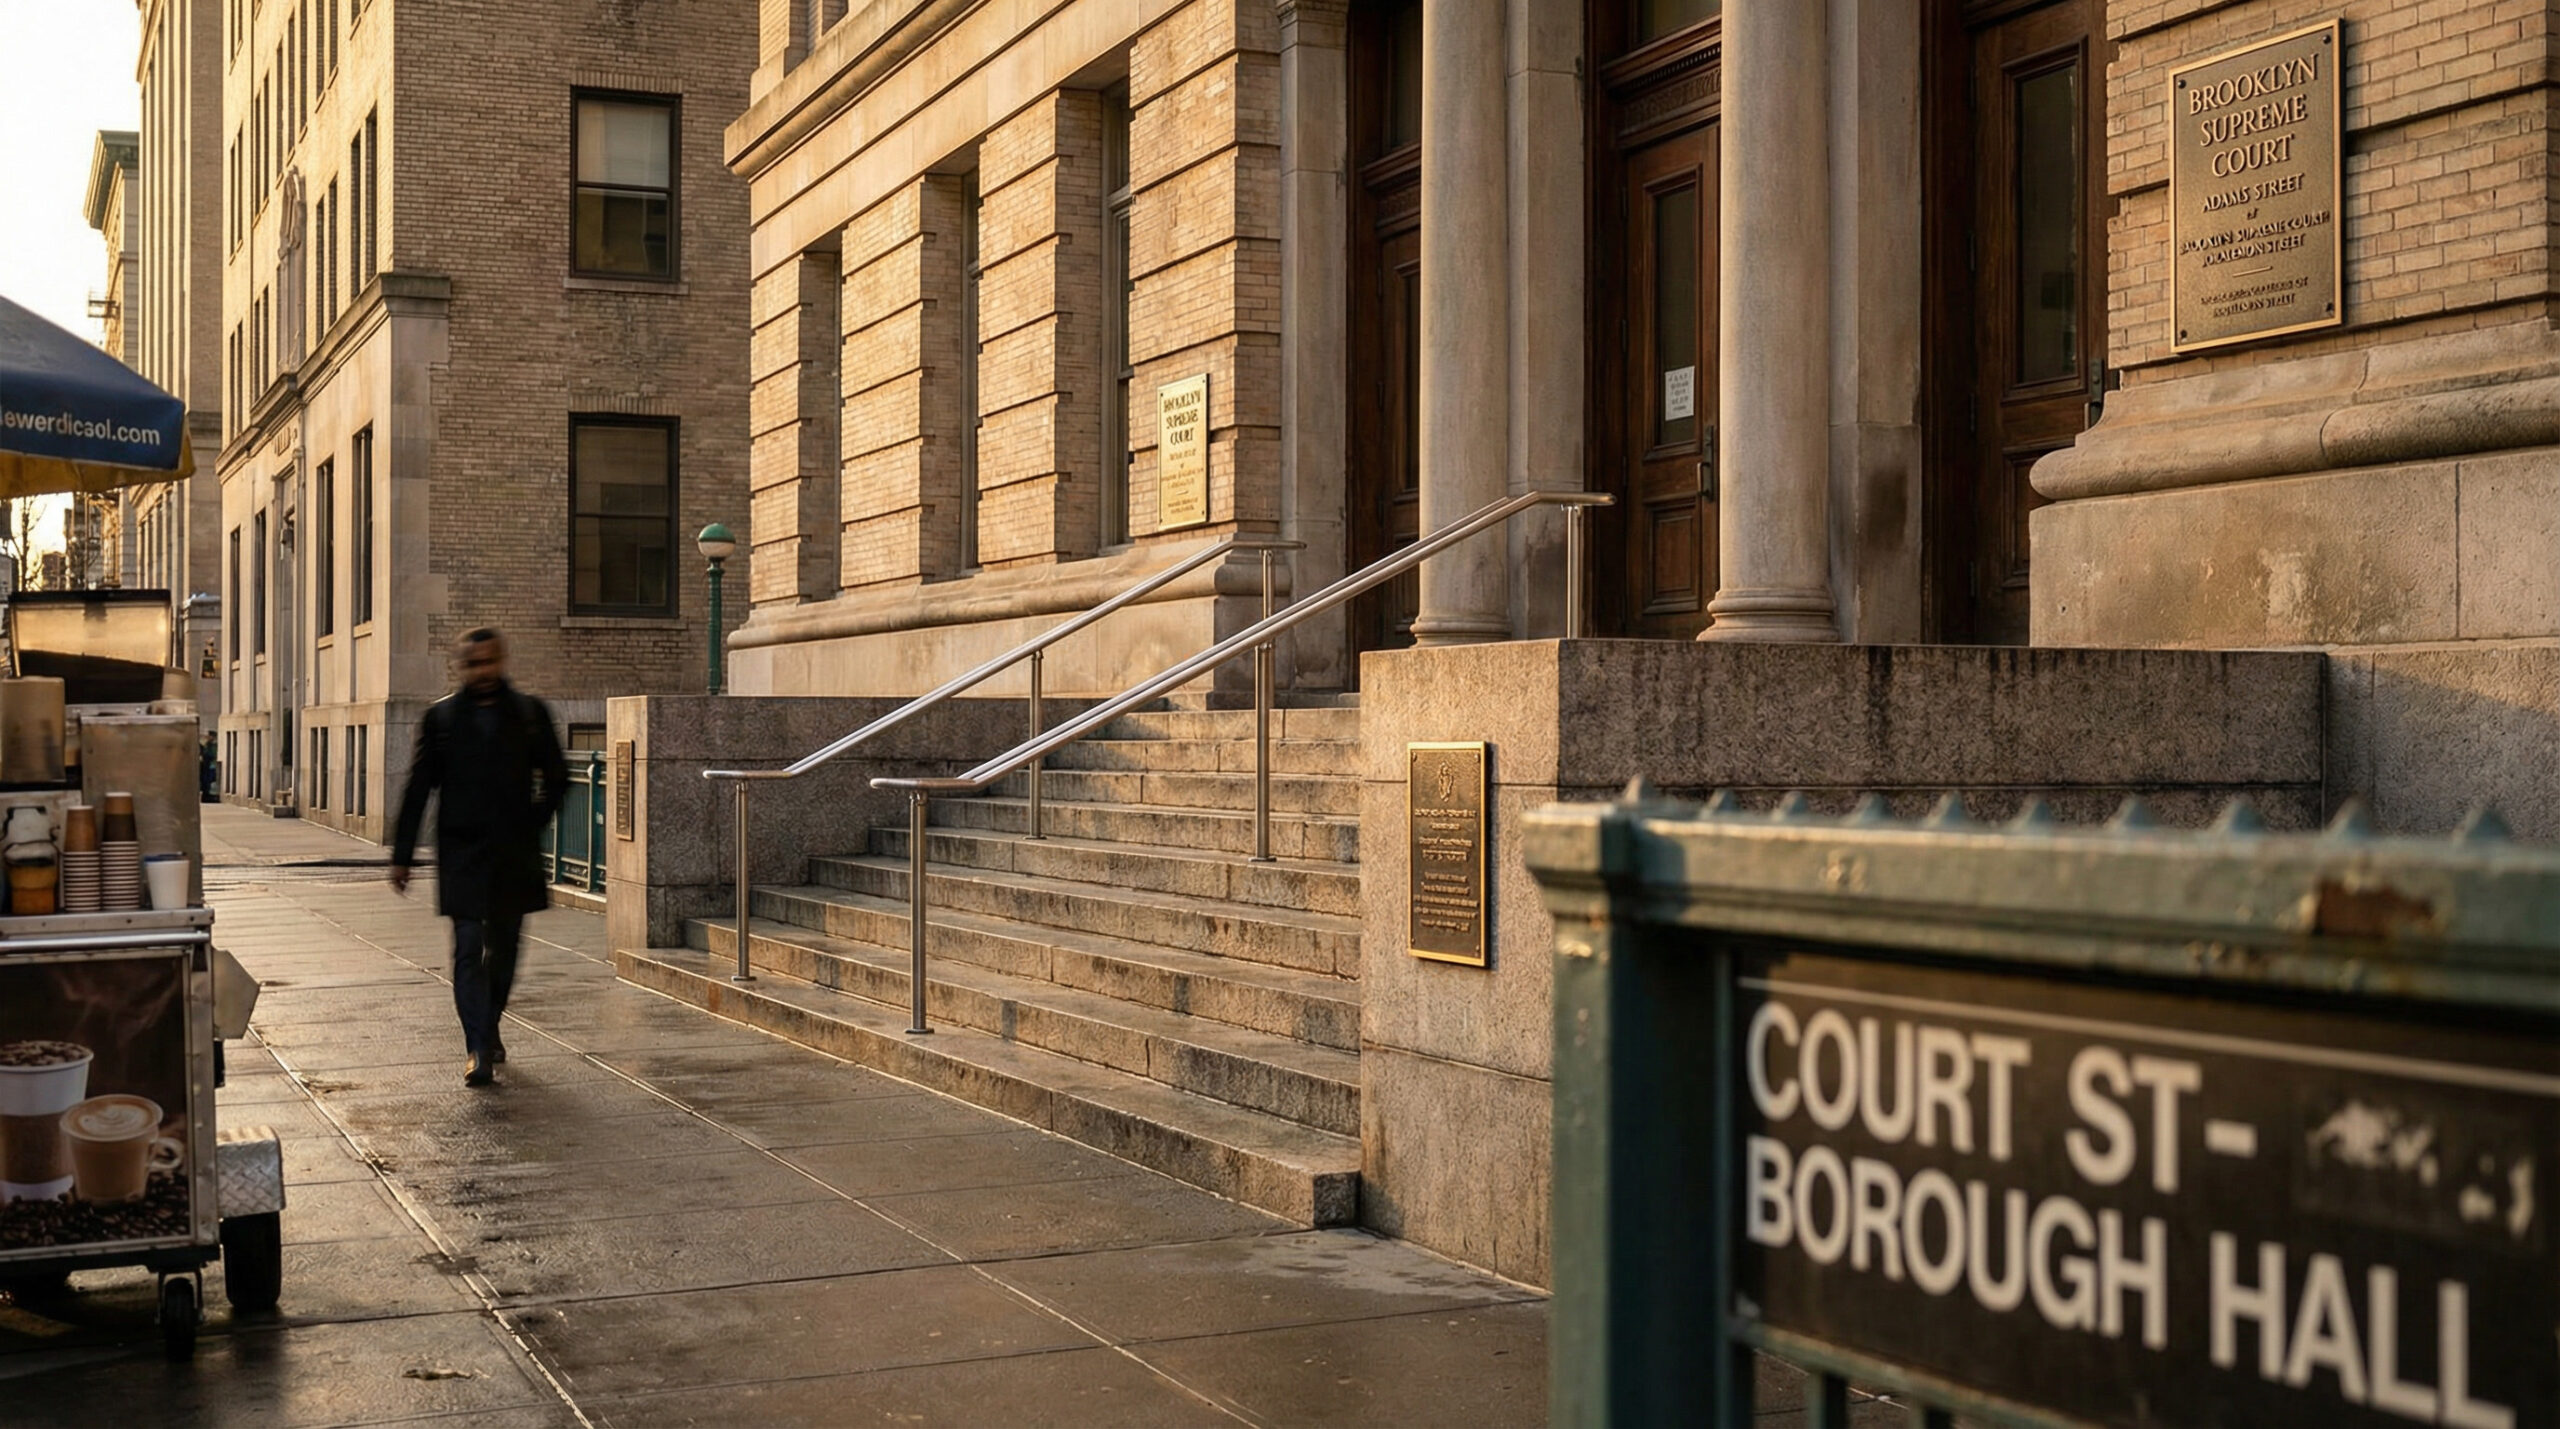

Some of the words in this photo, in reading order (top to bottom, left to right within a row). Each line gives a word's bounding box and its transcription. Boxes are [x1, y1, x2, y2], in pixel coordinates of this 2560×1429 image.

[2189, 53, 2319, 115] BROOKLYN
[2200, 94, 2308, 147] SUPREME
[2212, 133, 2295, 177] COURT
[2203, 186, 2251, 213] ADAMS
[2253, 172, 2305, 201] STREET
[0, 407, 160, 445] ewerdicaol.com
[1747, 1003, 2031, 1161] COURT
[1747, 1136, 2167, 1350] BOROUGH
[2210, 1232, 2516, 1429] HALL
